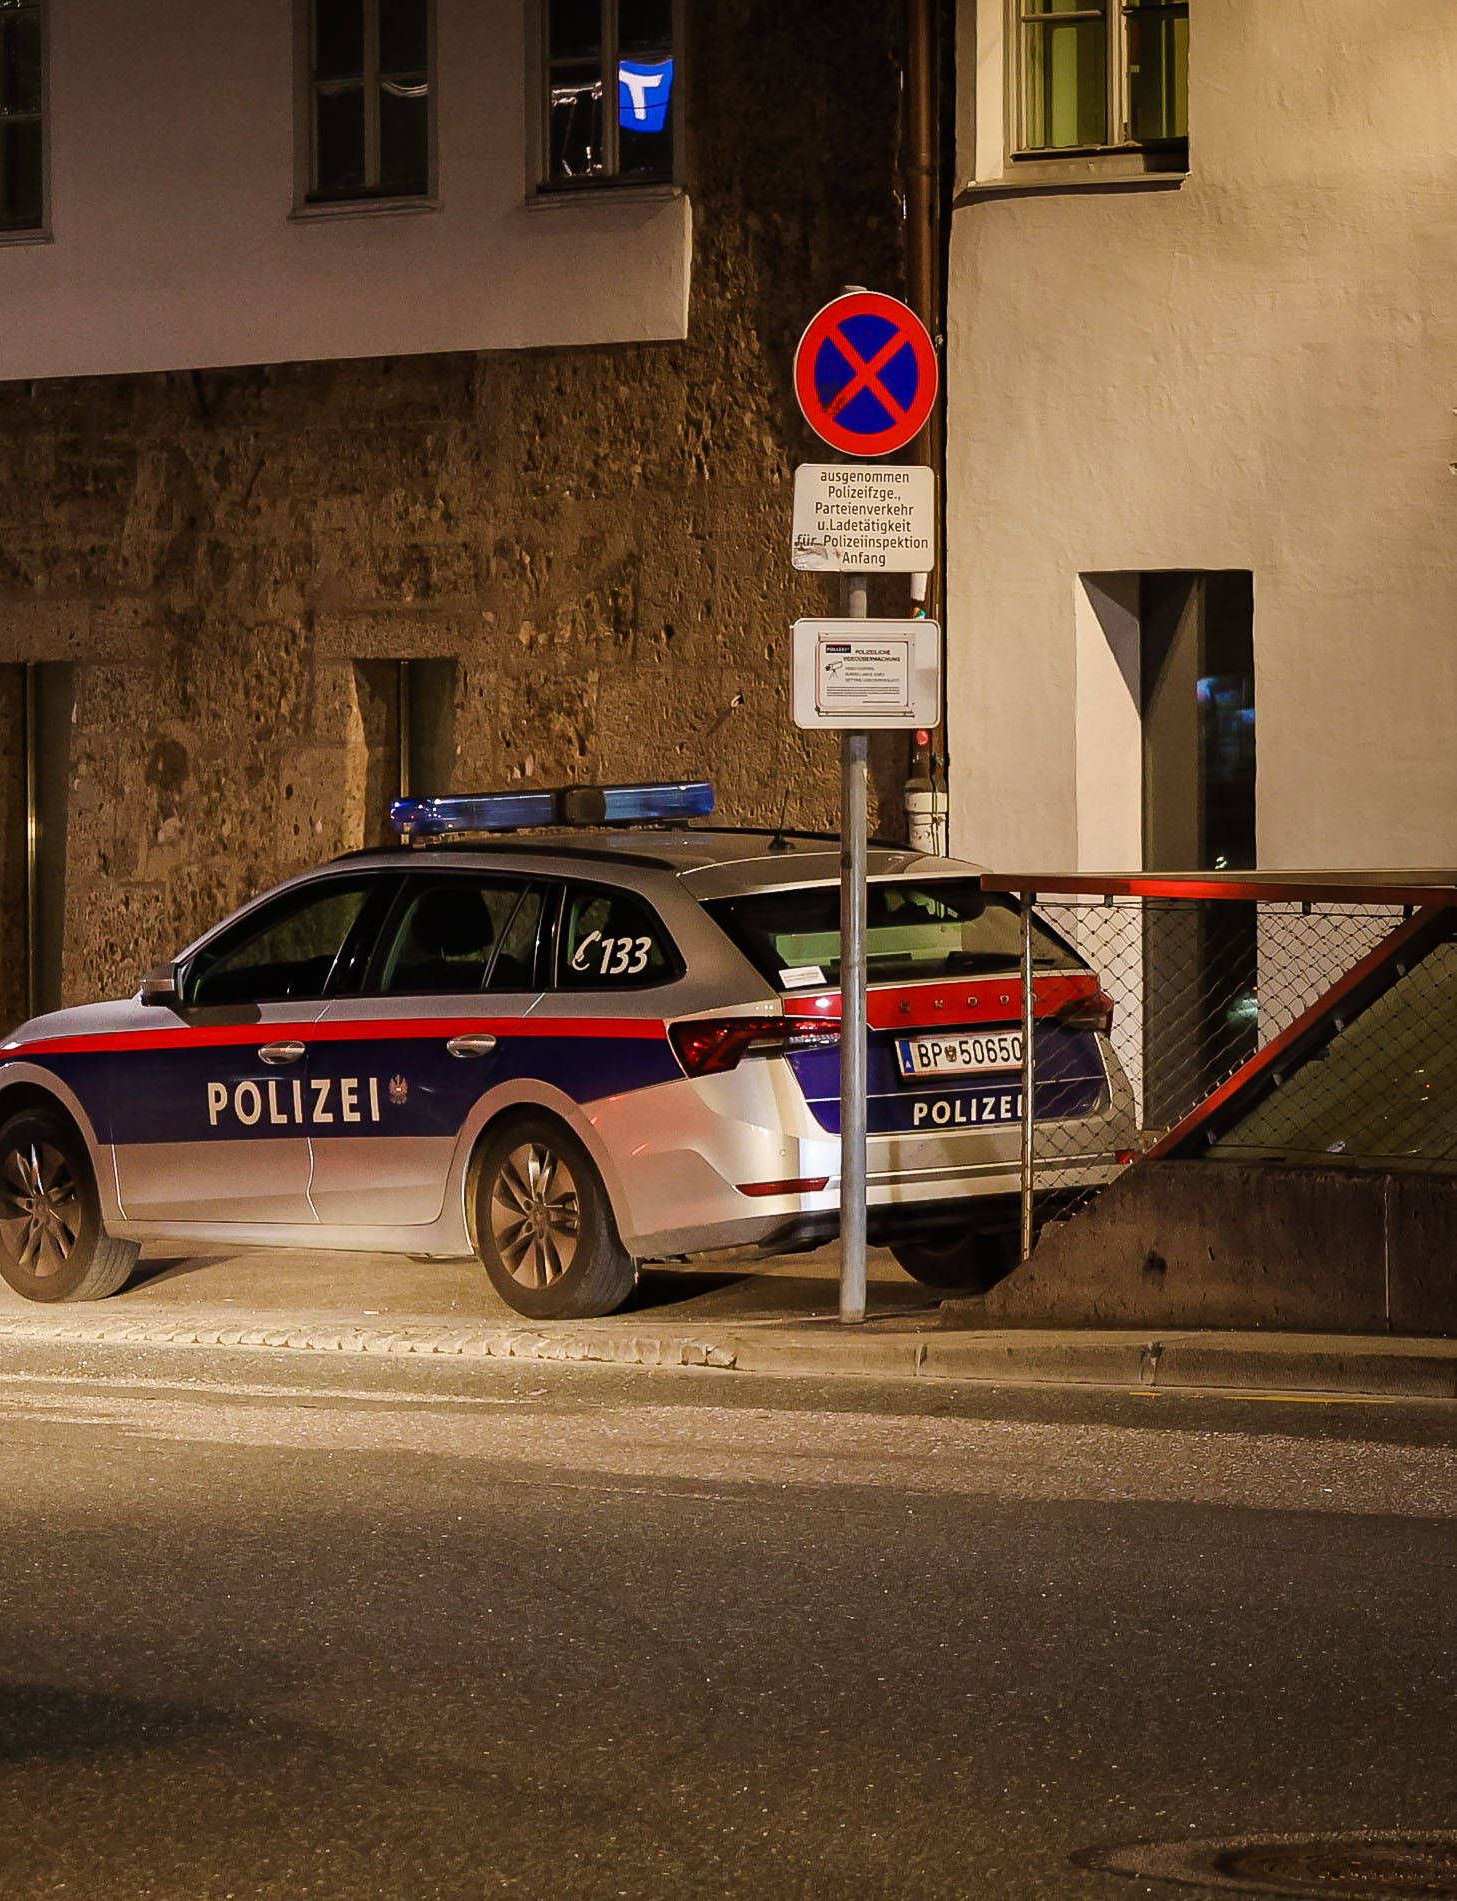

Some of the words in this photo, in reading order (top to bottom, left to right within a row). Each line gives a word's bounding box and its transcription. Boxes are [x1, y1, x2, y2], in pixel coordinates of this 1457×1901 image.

[820, 471, 909, 485] ausgenommen
[828, 485, 901, 502] Polizeifzge.,
[815, 502, 914, 516] Parteienverkehr
[817, 518, 912, 534] u.Ladetätigkeit
[823, 535, 928, 550] Polizeiinspektion
[842, 552, 886, 567] Anfang
[599, 937, 652, 974] 133
[918, 1043, 942, 1067] BP
[959, 1037, 1023, 1064] 50650
[207, 1077, 380, 1126] POLIZEI
[913, 1094, 1023, 1126] POLIZEI
